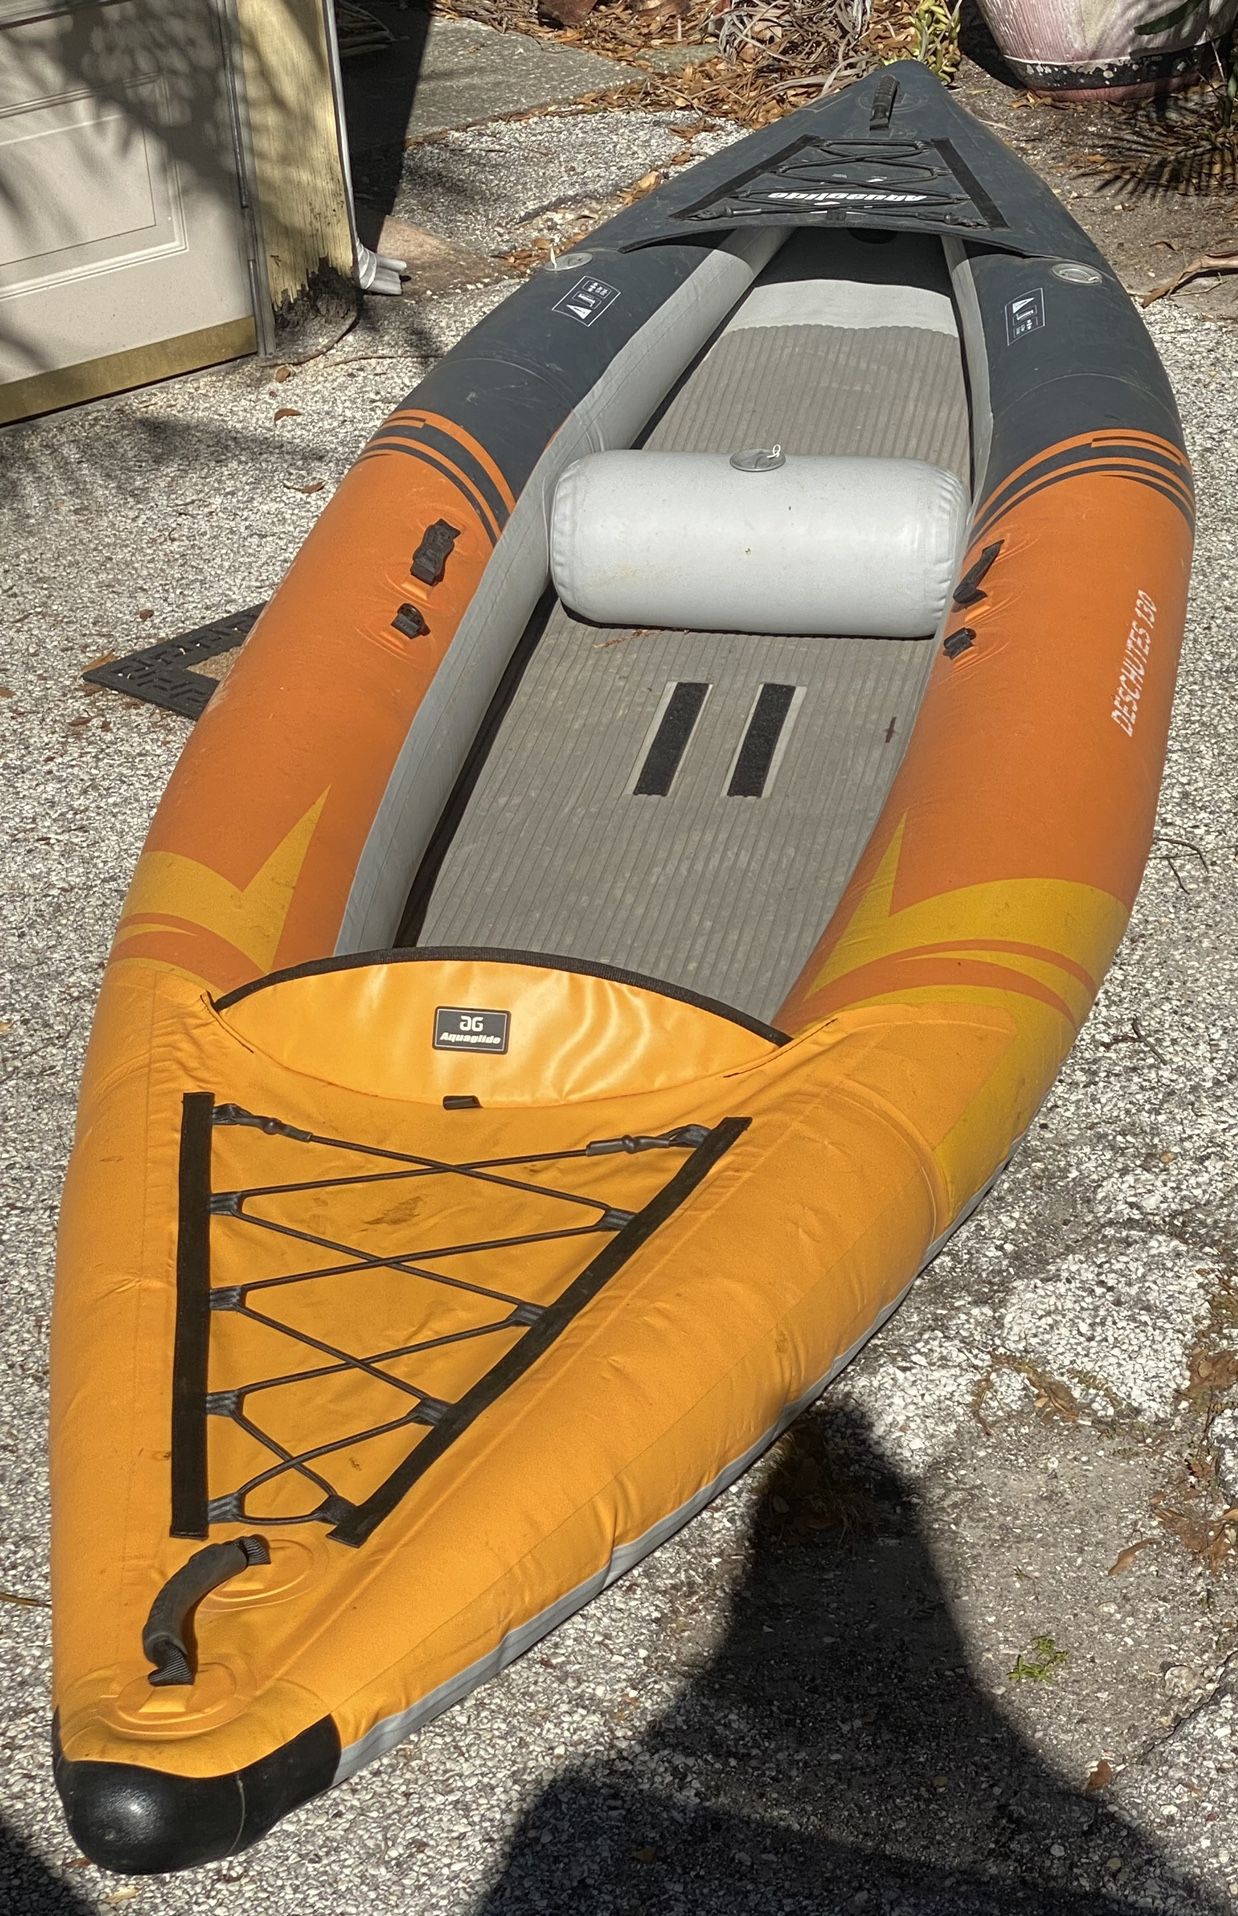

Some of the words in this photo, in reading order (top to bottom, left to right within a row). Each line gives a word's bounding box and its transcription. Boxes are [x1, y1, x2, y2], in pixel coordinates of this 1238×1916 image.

[1110, 621, 1151, 738] DESCHUTES
[1134, 589, 1157, 629] 130
[440, 1032, 502, 1045] Aquaglide
